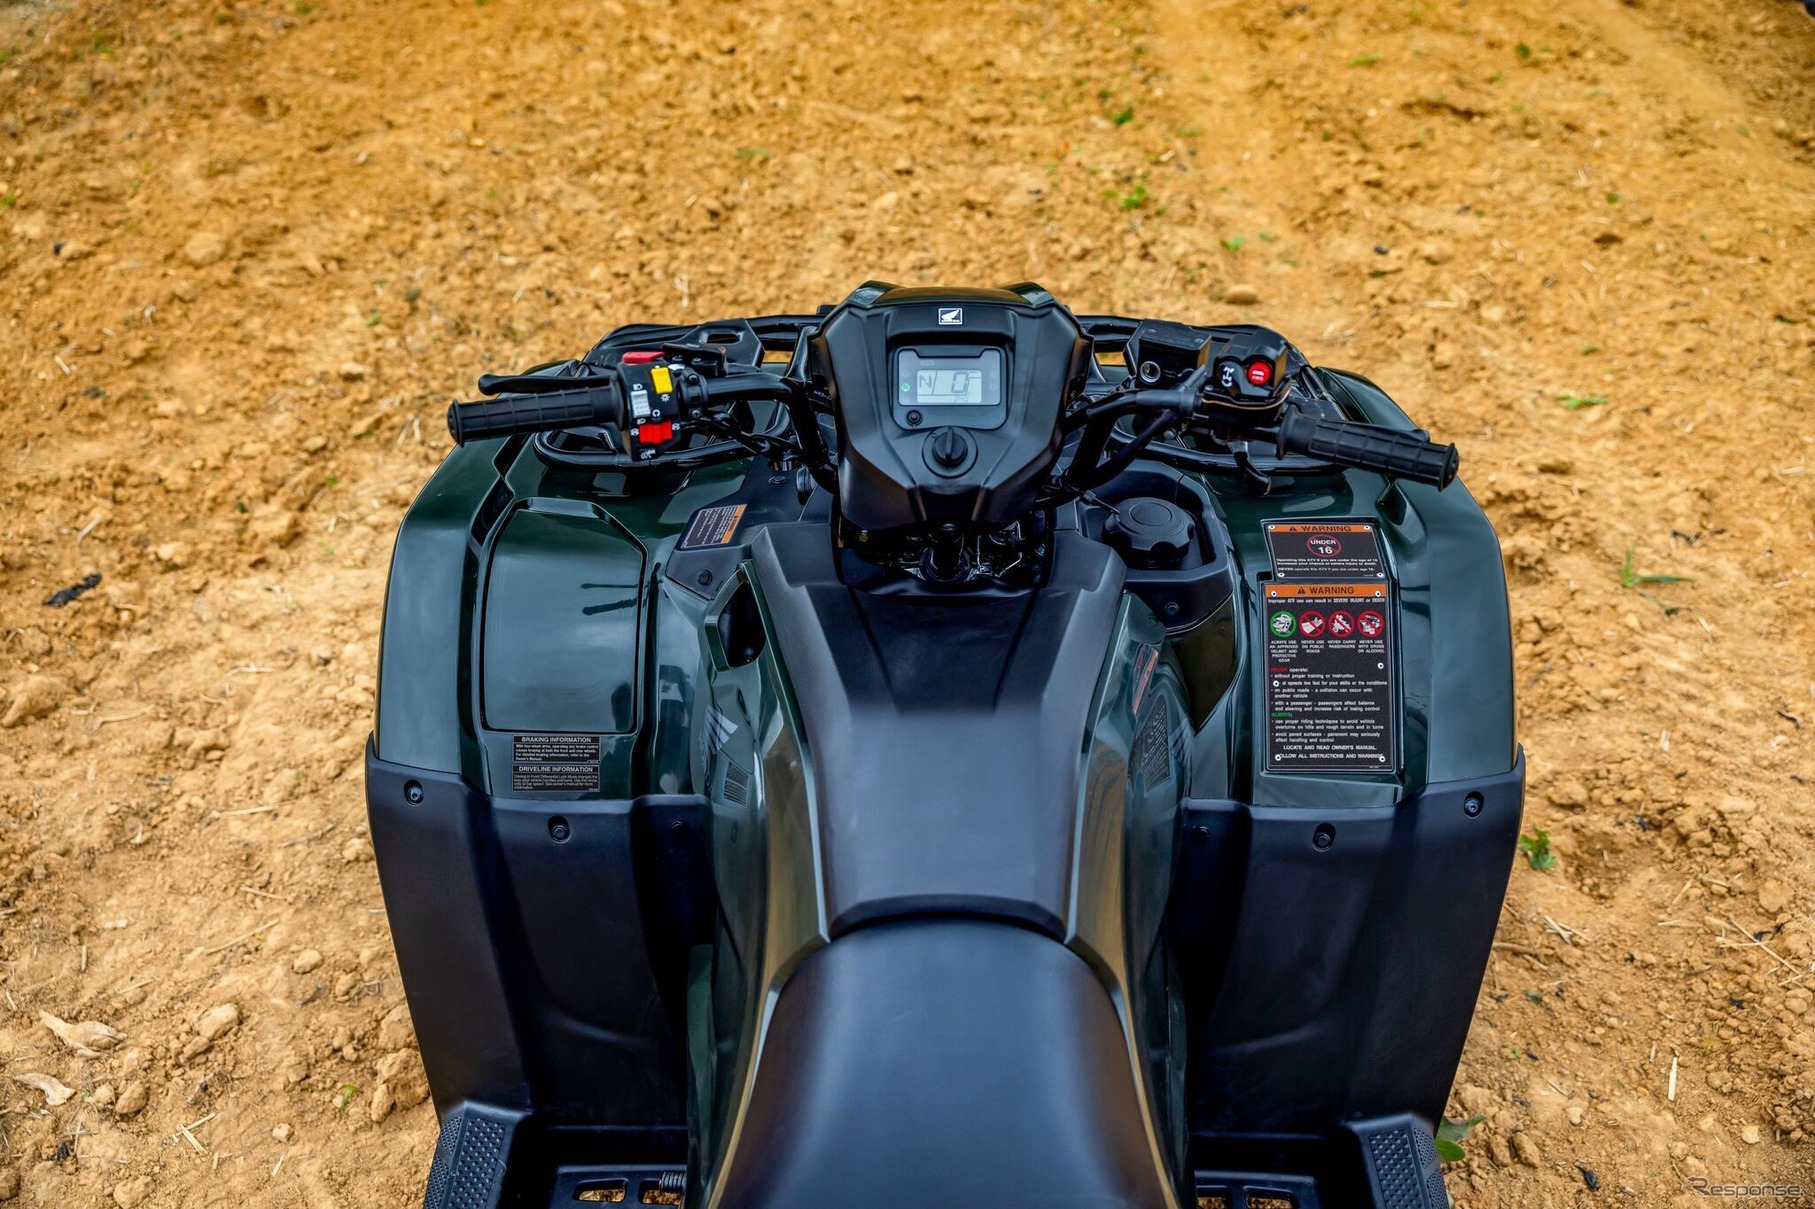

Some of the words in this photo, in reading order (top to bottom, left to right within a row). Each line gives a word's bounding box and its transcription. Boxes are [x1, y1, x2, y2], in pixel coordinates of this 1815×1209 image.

[919, 374, 932, 388] N
[951, 371, 969, 394] 0
[1317, 546, 1333, 554] 16
[1309, 586, 1355, 594] WARNING
